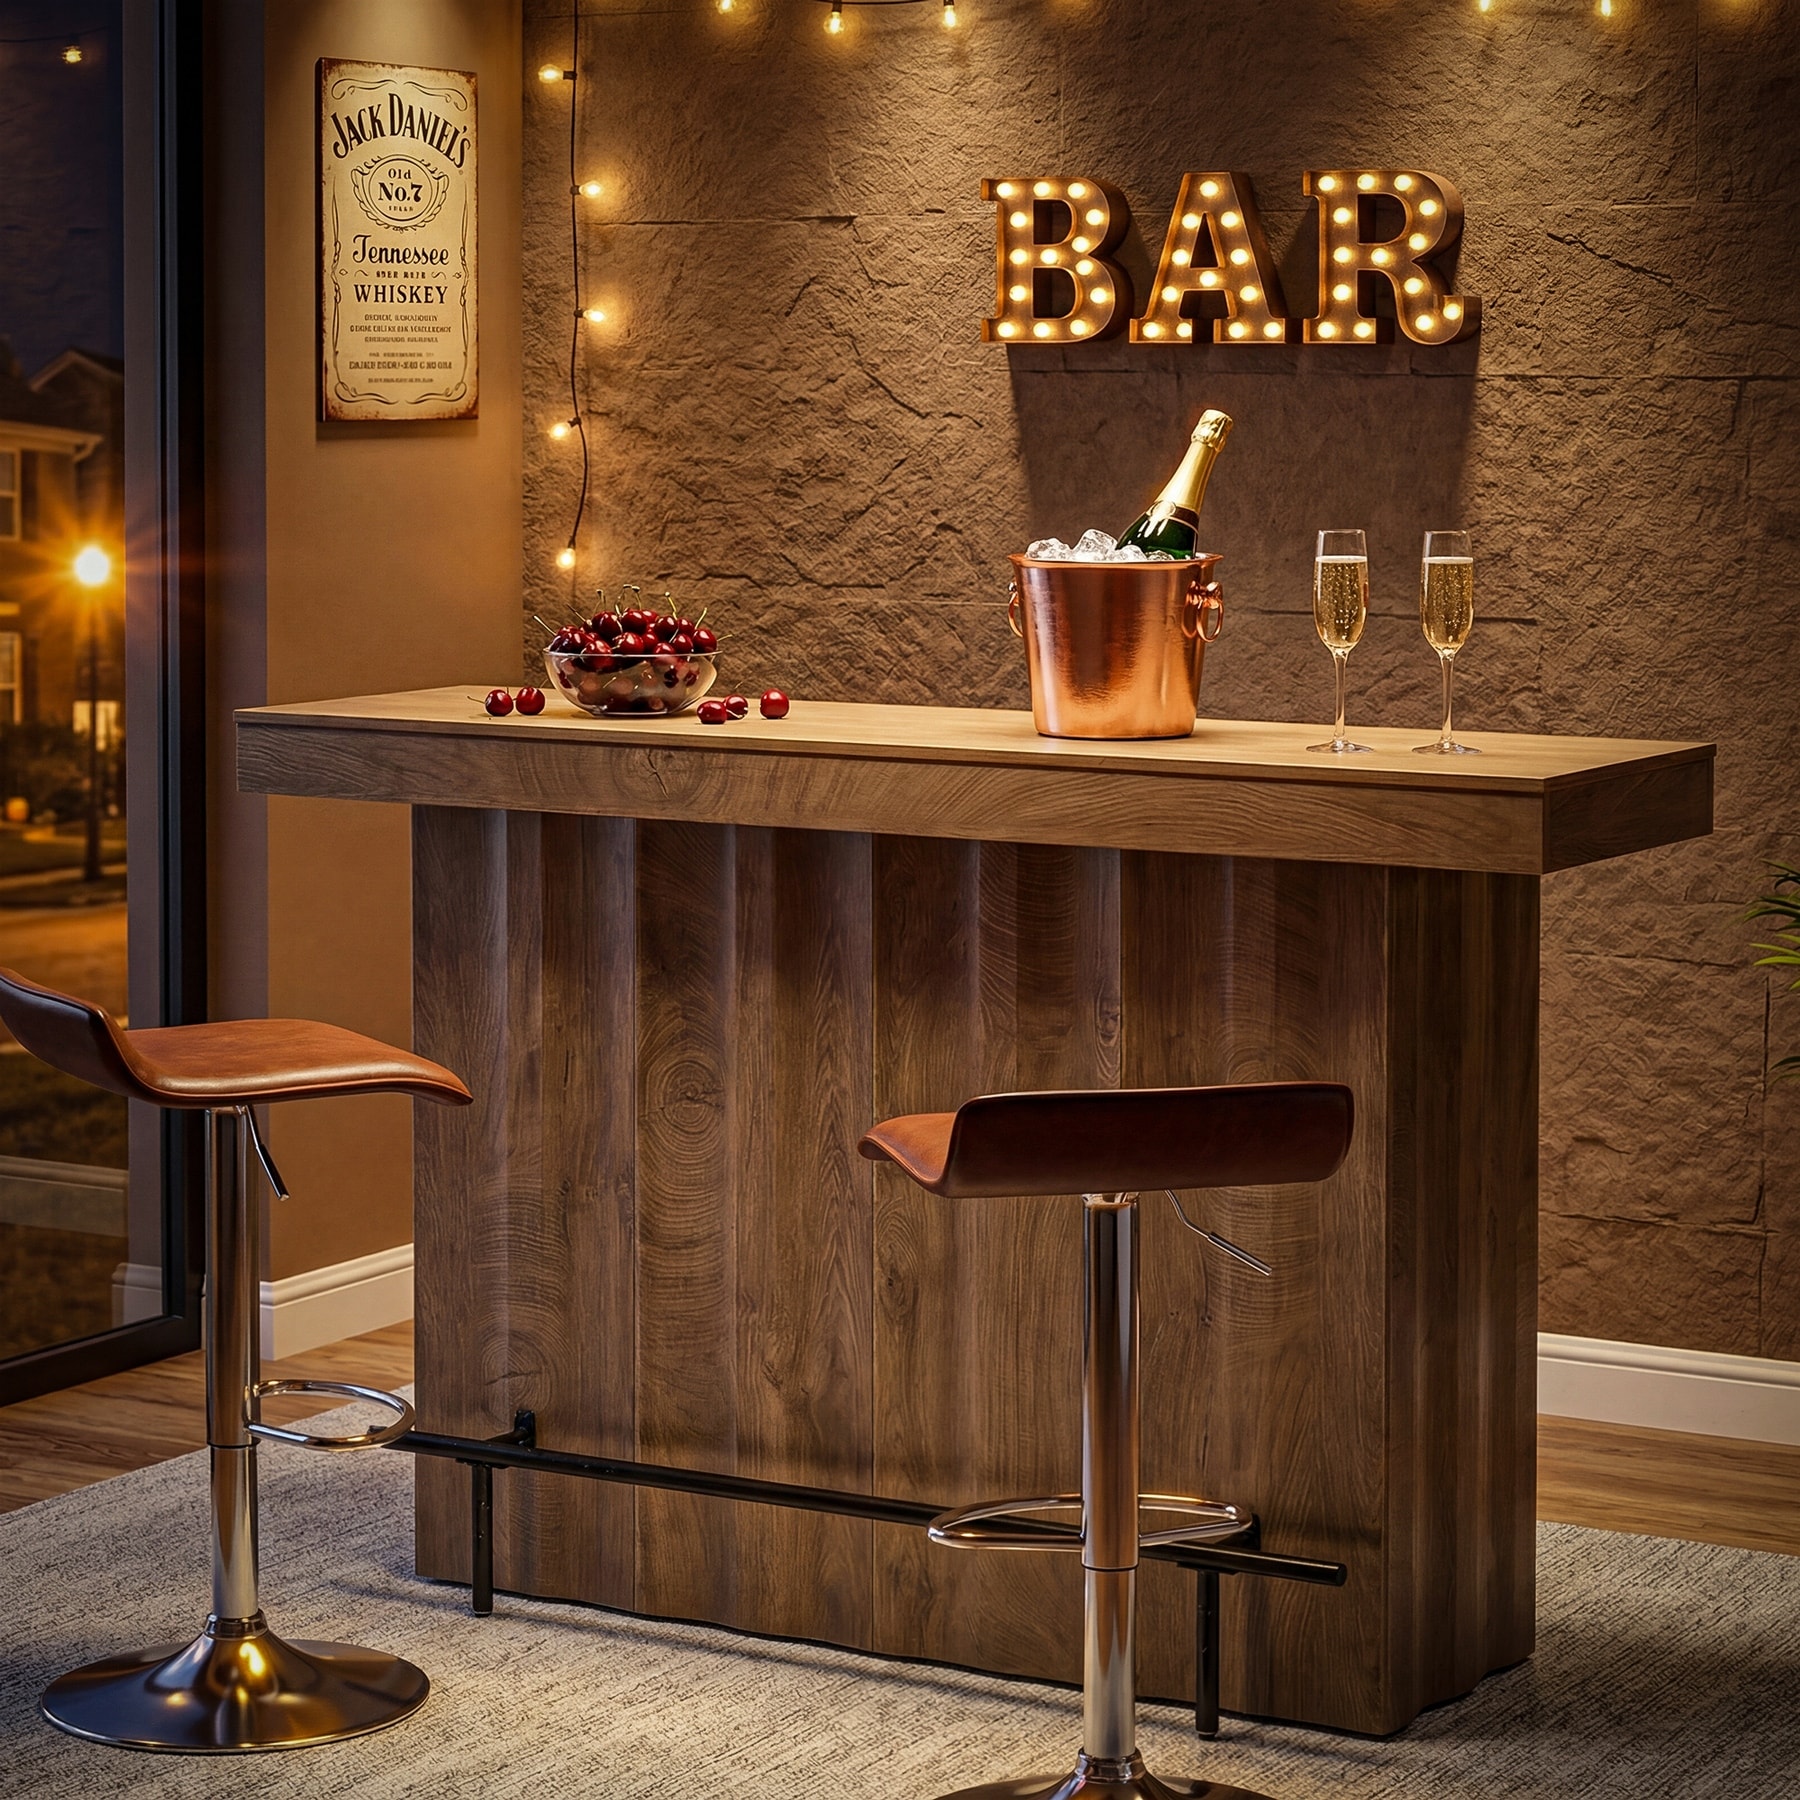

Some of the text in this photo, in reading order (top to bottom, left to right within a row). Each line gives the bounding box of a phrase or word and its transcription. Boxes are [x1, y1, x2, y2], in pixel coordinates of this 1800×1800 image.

[330, 93, 471, 168] JACK DANIEL'S
[388, 168, 412, 180] Old
[378, 182, 423, 202] No.7
[352, 234, 450, 265] Tennessee
[981, 170, 1482, 345] BAR
[353, 284, 448, 304] WHISKEY
